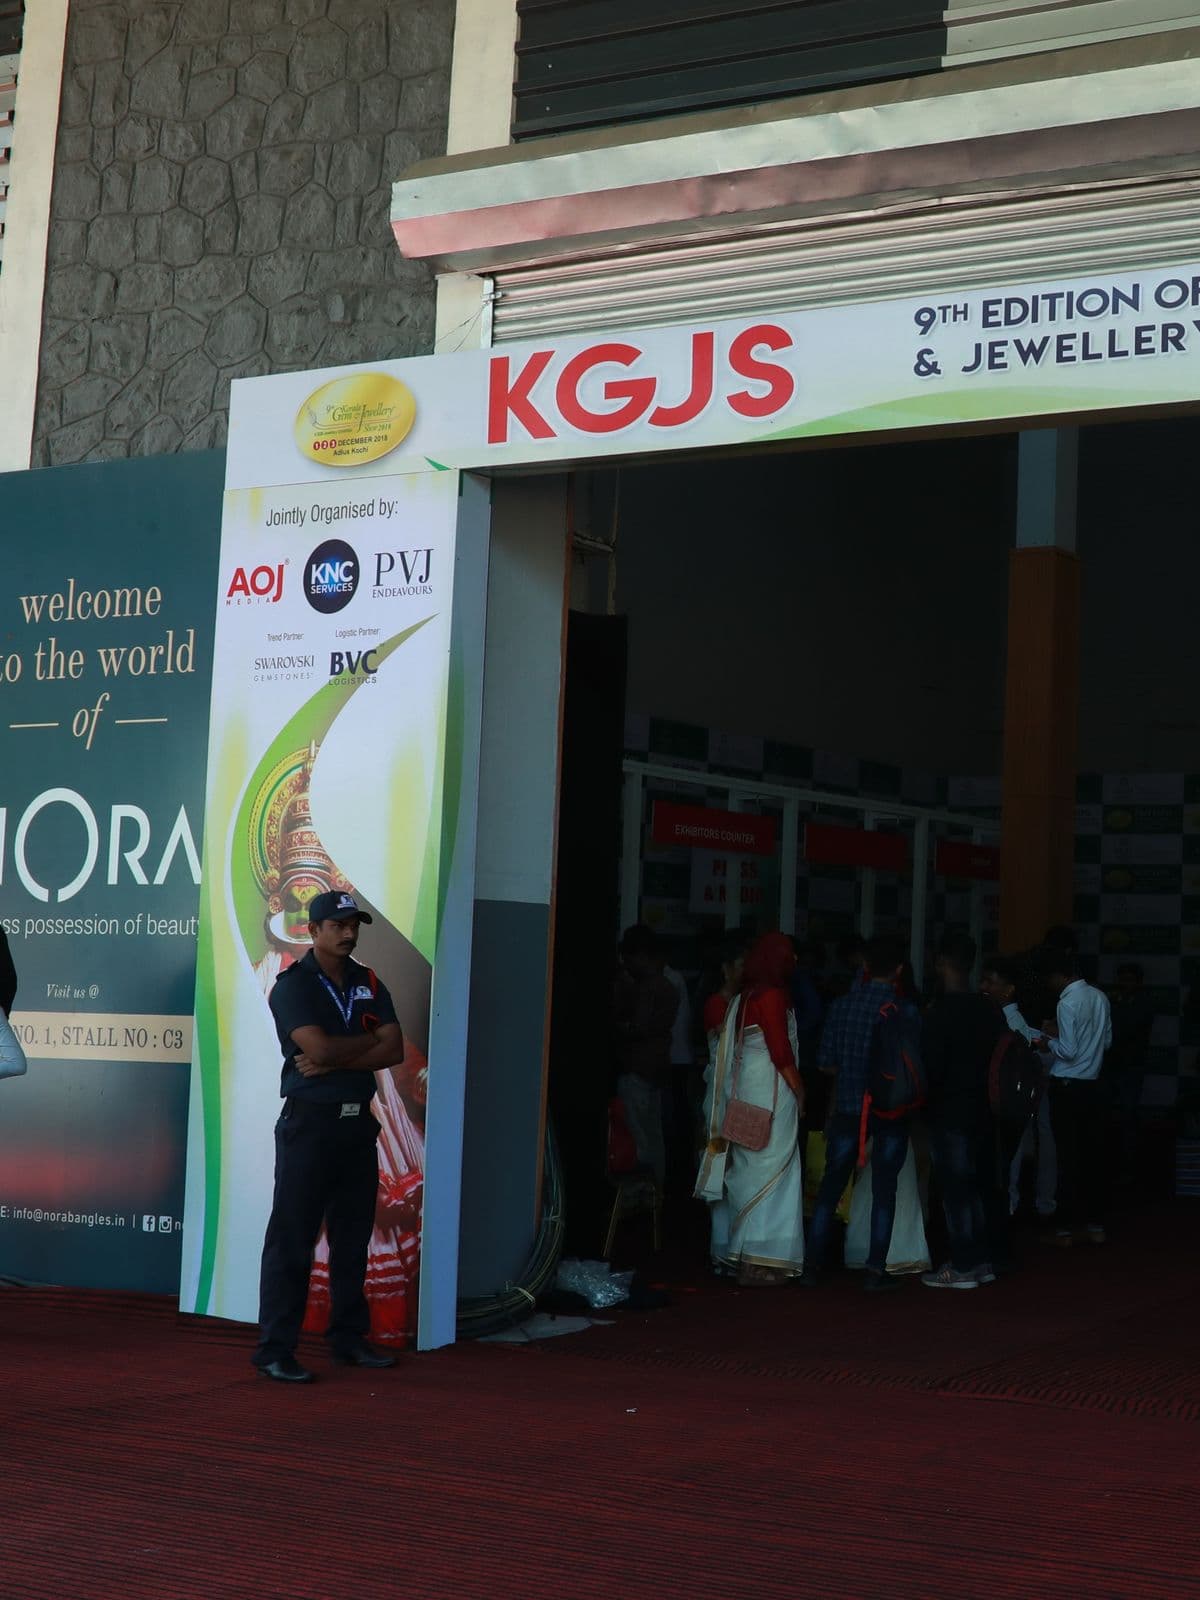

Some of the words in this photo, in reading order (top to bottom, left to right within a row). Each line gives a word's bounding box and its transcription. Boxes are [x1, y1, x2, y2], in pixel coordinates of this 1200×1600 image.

[913, 302, 968, 336] 9TH
[982, 283, 1140, 329] EDITION
[913, 348, 942, 377] &
[488, 324, 795, 444] KGJS
[338, 437, 372, 446] DECEMBER
[266, 509, 307, 527] Jointly
[310, 499, 374, 523] Organised
[379, 498, 399, 520] by:
[311, 561, 354, 584] KNC
[373, 549, 434, 587] PVJ
[227, 564, 285, 603] AOJ
[310, 583, 353, 595] SERVICES
[372, 585, 433, 599] ENDEAVOURS
[19, 578, 162, 624] welcome
[226, 597, 270, 606] MEDIA
[267, 633, 282, 642] Trend
[283, 632, 304, 642] Partner
[335, 628, 357, 640] Logistic
[358, 627, 380, 637] Partner
[34, 637, 84, 681] the
[97, 629, 195, 677] world
[254, 655, 314, 670] SWAROVSKI
[329, 649, 378, 676] BVC
[254, 672, 312, 682] GEMSTONES
[328, 676, 377, 686] LOGISTICS
[72, 692, 110, 750] of
[675, 824, 720, 840] EXHIBITORS
[721, 830, 755, 844] COUNTER
[24, 914, 119, 939] possession
[124, 913, 144, 935] of
[47, 984, 72, 998] Visit
[74, 987, 86, 998] us
[88, 984, 100, 999] @
[62, 1026, 118, 1047] STALL
[162, 1028, 183, 1049] C3
[13, 1206, 125, 1228] info@norabangles.in
